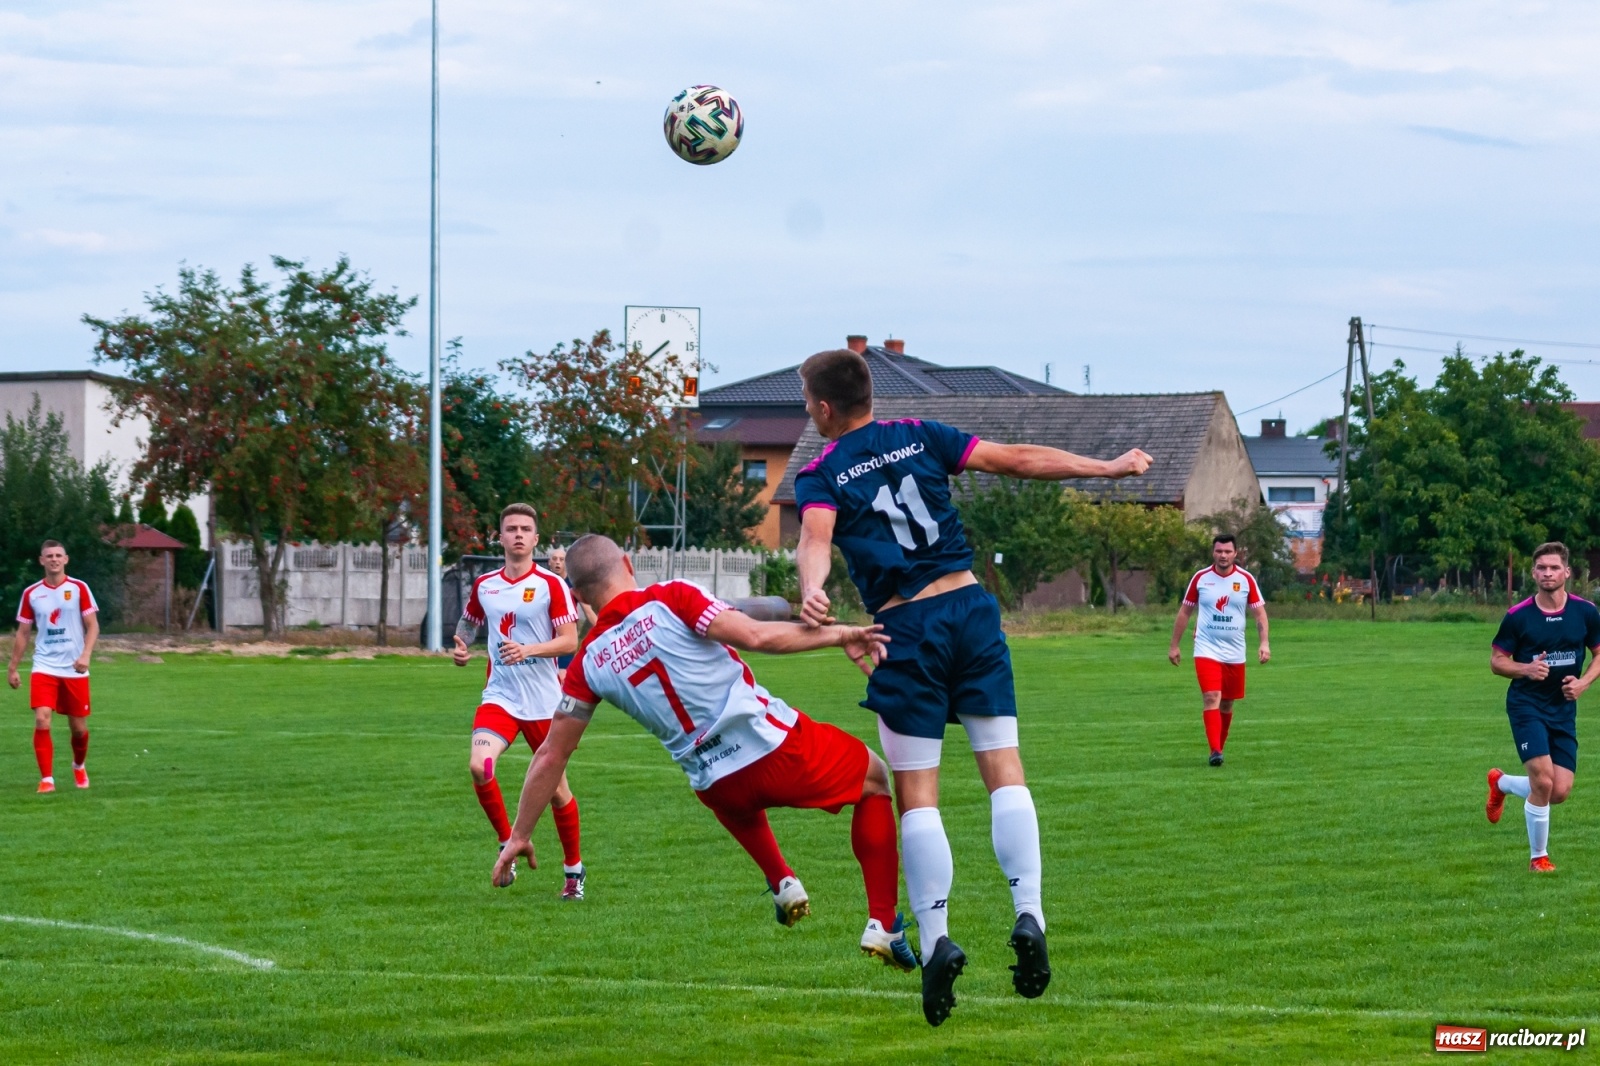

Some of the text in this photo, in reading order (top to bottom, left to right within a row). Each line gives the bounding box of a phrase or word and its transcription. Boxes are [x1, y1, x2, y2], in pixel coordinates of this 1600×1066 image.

[660, 313, 666, 323] 0
[686, 341, 695, 352] 15
[871, 473, 940, 551] 11
[611, 614, 657, 655] ZAMECZEK
[611, 636, 655, 674] CZERNICA
[627, 656, 697, 736] 7
